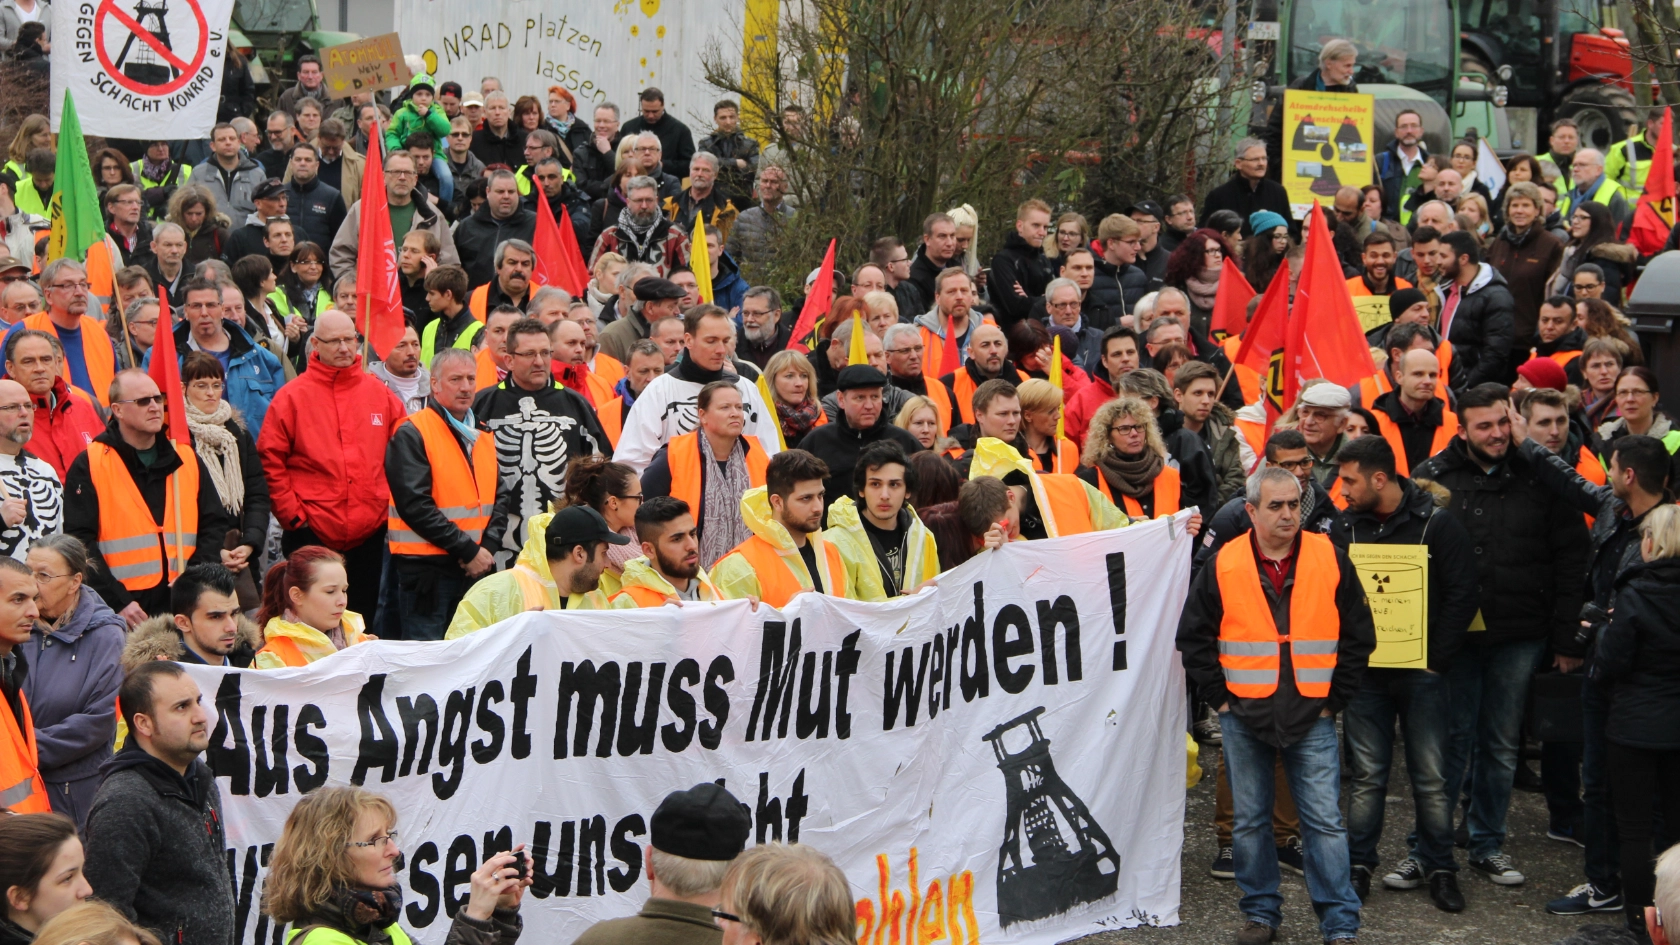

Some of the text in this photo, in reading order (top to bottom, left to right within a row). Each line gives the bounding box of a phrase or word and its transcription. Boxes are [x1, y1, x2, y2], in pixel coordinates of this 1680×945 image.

[76, 3, 95, 63] GEGEN
[90, 71, 162, 112] SCHACHT
[167, 66, 215, 112] KONRAD
[536, 51, 607, 102] lassen
[206, 673, 329, 798] Aus
[350, 644, 537, 800] Angst
[554, 655, 734, 760] muss
[745, 617, 861, 742] Mut
[882, 581, 1083, 730] werden
[529, 814, 647, 900] uns
